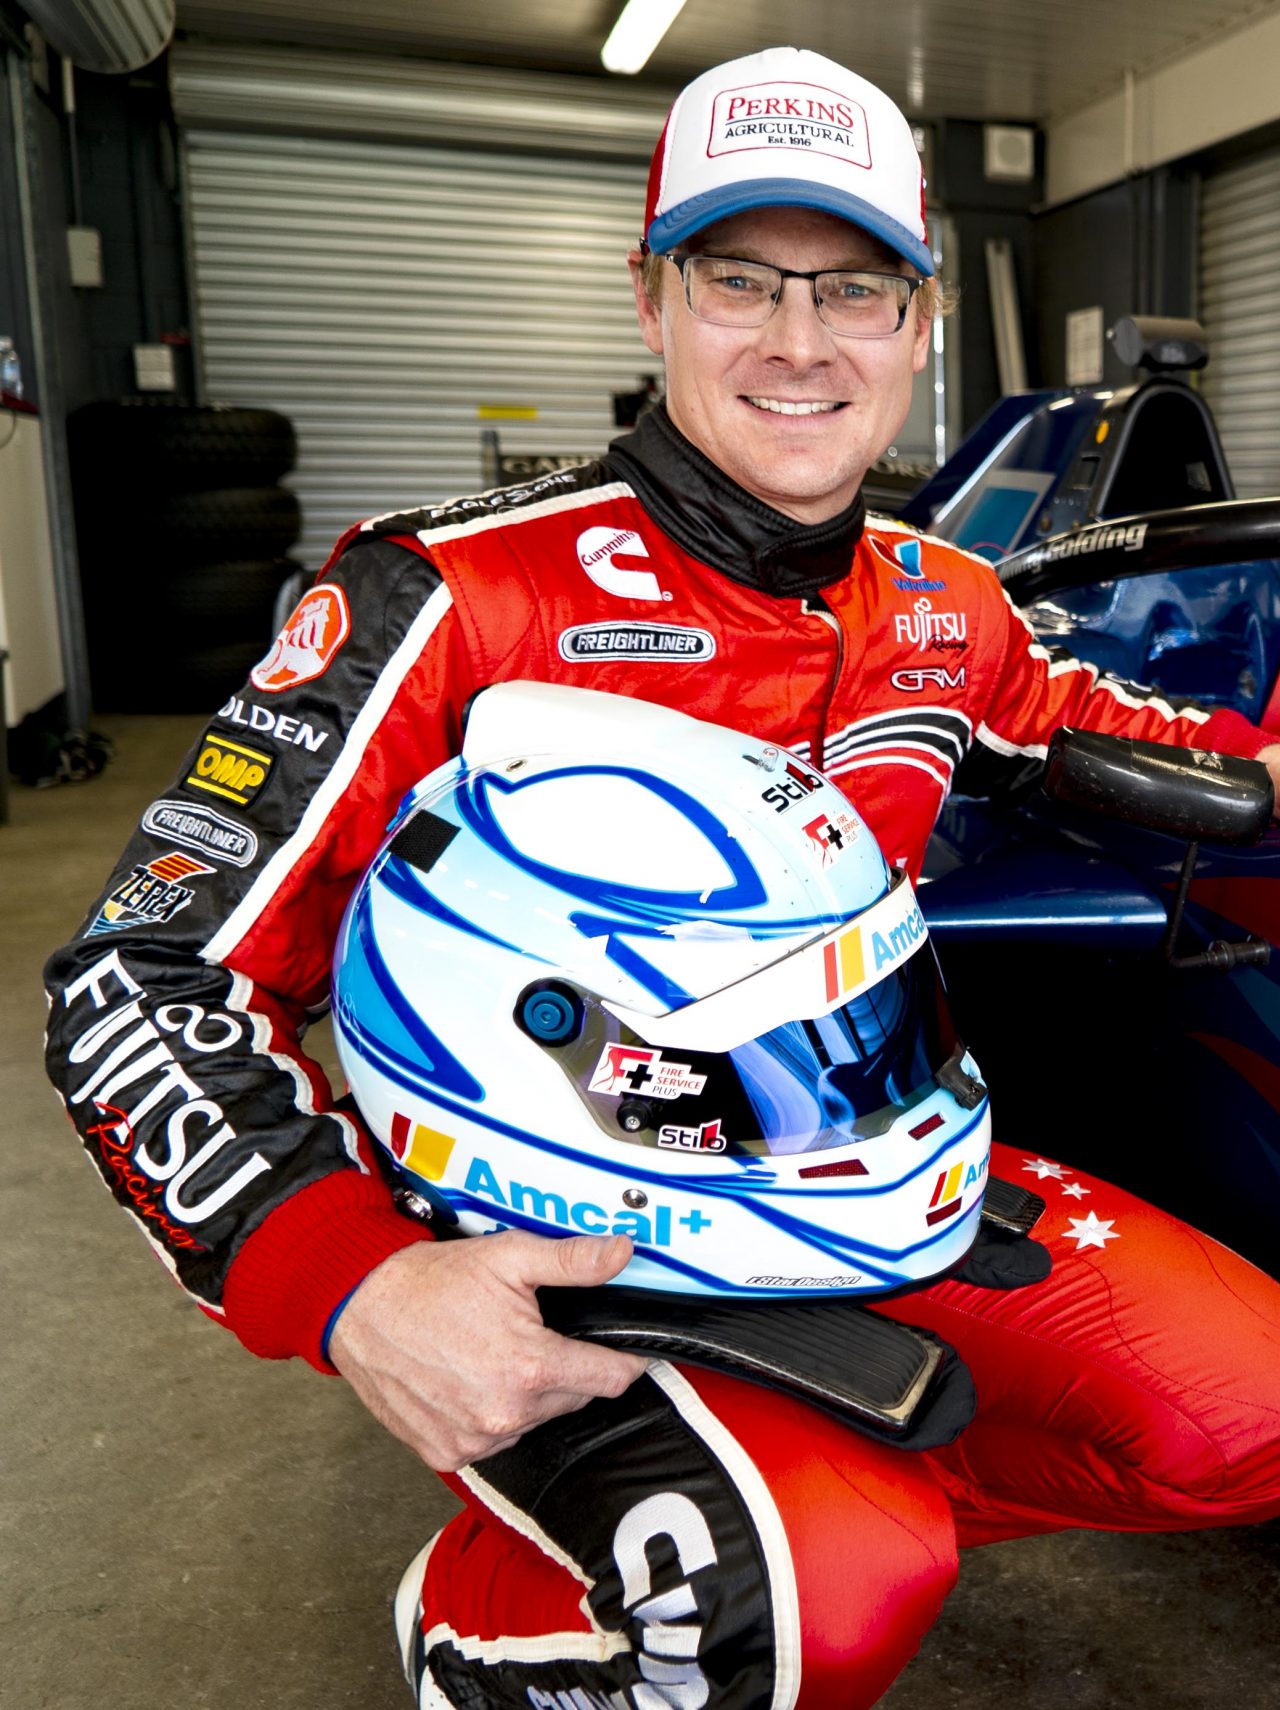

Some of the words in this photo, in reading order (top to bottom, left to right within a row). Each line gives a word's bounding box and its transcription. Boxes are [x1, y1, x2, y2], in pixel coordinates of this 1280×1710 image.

[727, 97, 854, 129] PERKINS
[725, 122, 854, 147] AGRICULTURAL
[768, 136, 787, 145] Est.
[790, 136, 812, 147] 1916
[581, 530, 636, 567] Cummins
[1047, 522, 1149, 562] Golding
[891, 577, 948, 593] Valvoline
[576, 631, 698, 652] FREIGHTLINER
[893, 611, 967, 651] FUJITSU
[927, 633, 970, 659] Racing
[196, 747, 266, 791] OMP
[156, 809, 248, 854] FREIGHTLINER
[108, 863, 196, 923] ZEREX
[63, 948, 272, 1224] FUJITSU
[656, 1076, 702, 1090] SERVICE
[660, 1067, 685, 1077] FIRE
[652, 1085, 677, 1097] PLUS
